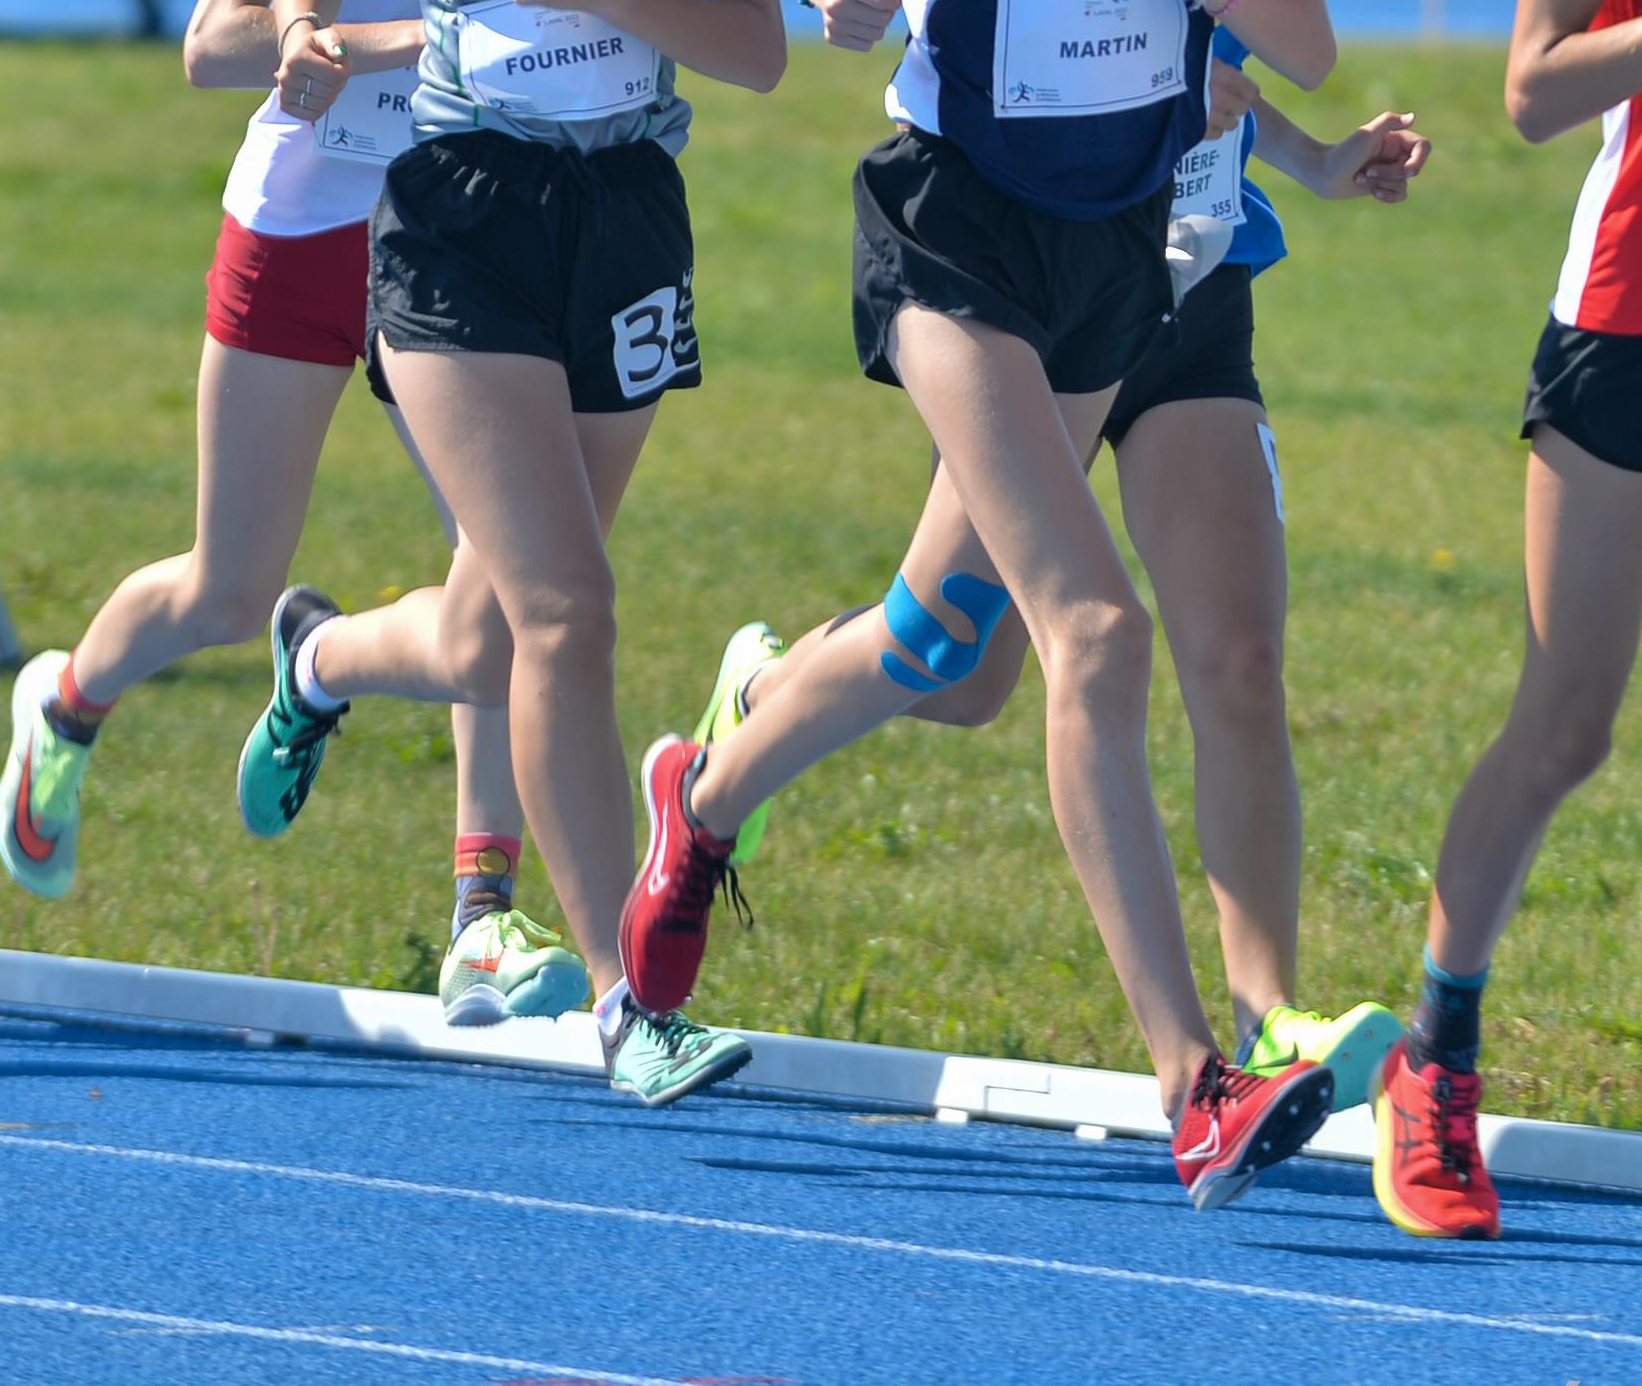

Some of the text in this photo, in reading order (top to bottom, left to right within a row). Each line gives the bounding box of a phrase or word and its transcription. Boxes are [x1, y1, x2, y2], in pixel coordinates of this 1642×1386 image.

[505, 36, 625, 76] FOURNIER
[1059, 32, 1148, 59] MARTIN
[624, 76, 651, 96] 912
[377, 92, 413, 113] PR
[1211, 199, 1232, 218] 355
[624, 305, 668, 382] 3
